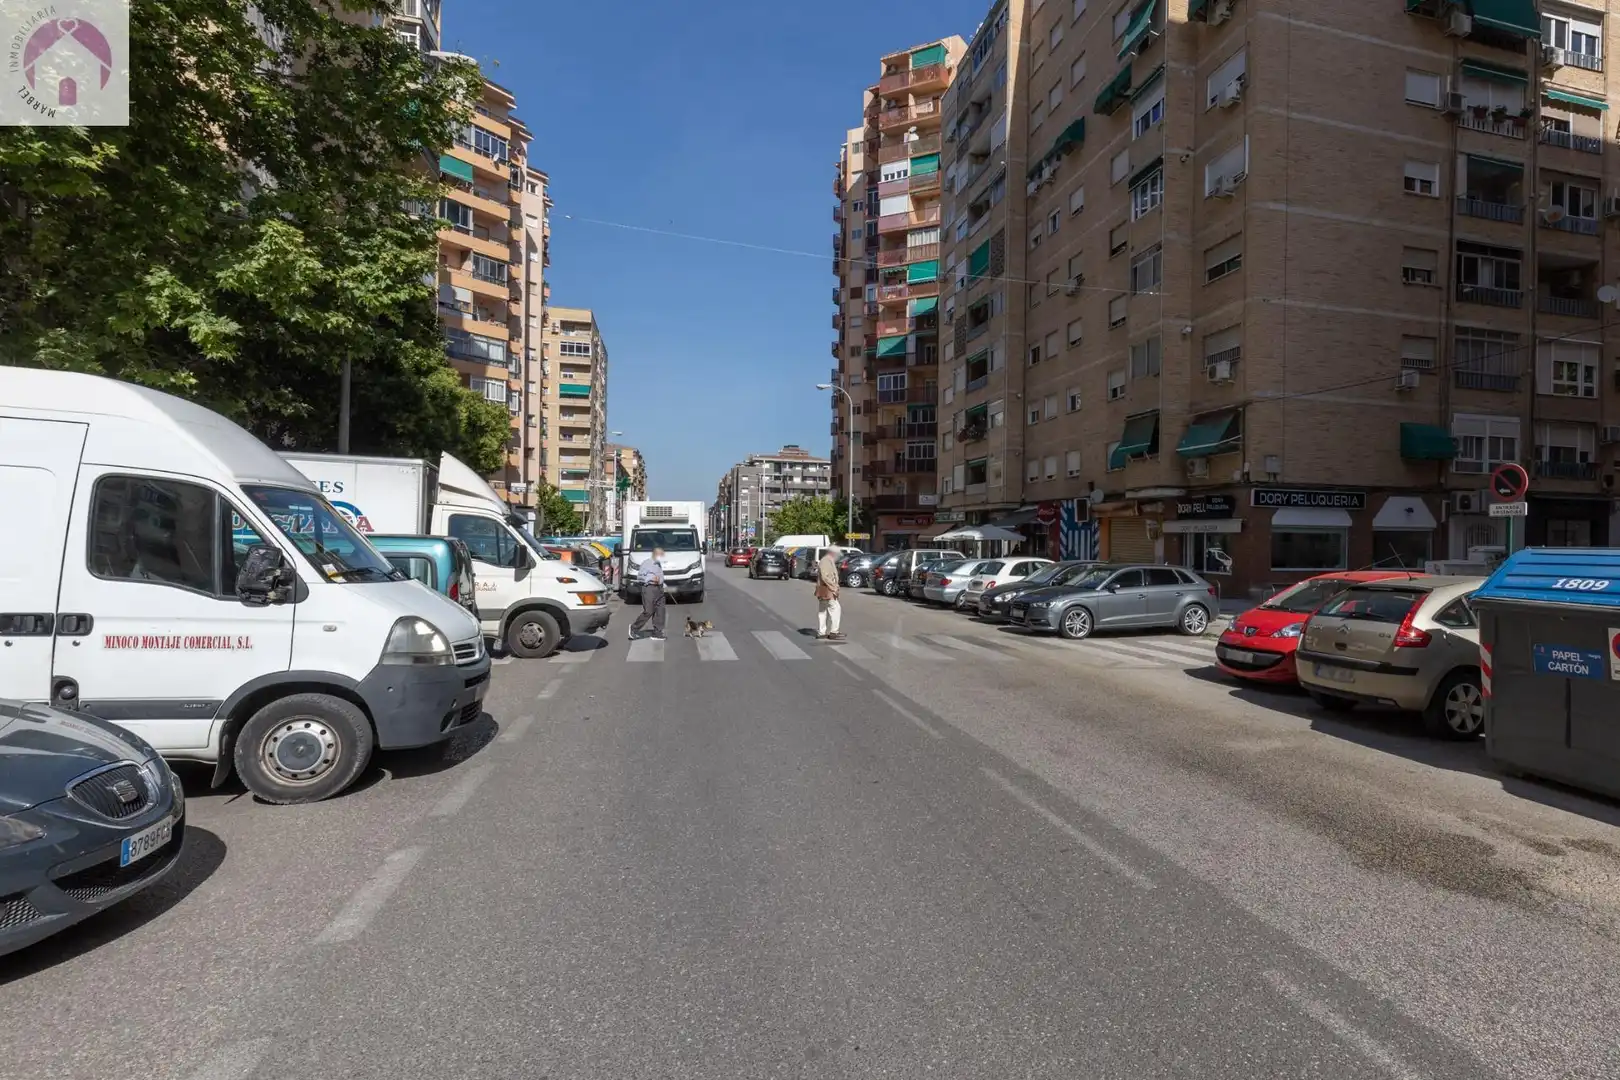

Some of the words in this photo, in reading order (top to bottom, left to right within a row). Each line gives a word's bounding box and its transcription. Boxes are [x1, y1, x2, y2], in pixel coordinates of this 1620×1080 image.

[1259, 492, 1289, 505] DORY
[1290, 493, 1360, 507] PELUQUERIA
[1177, 502, 1192, 514] DORY
[1551, 578, 1610, 591] 1809
[104, 635, 139, 649] MINOCO
[141, 635, 181, 649] MONTAJE
[183, 635, 235, 650] COMERCIAL,
[236, 635, 253, 649] S.L.
[1552, 650, 1584, 662] PAPEL
[1547, 661, 1589, 675] CARTÓN
